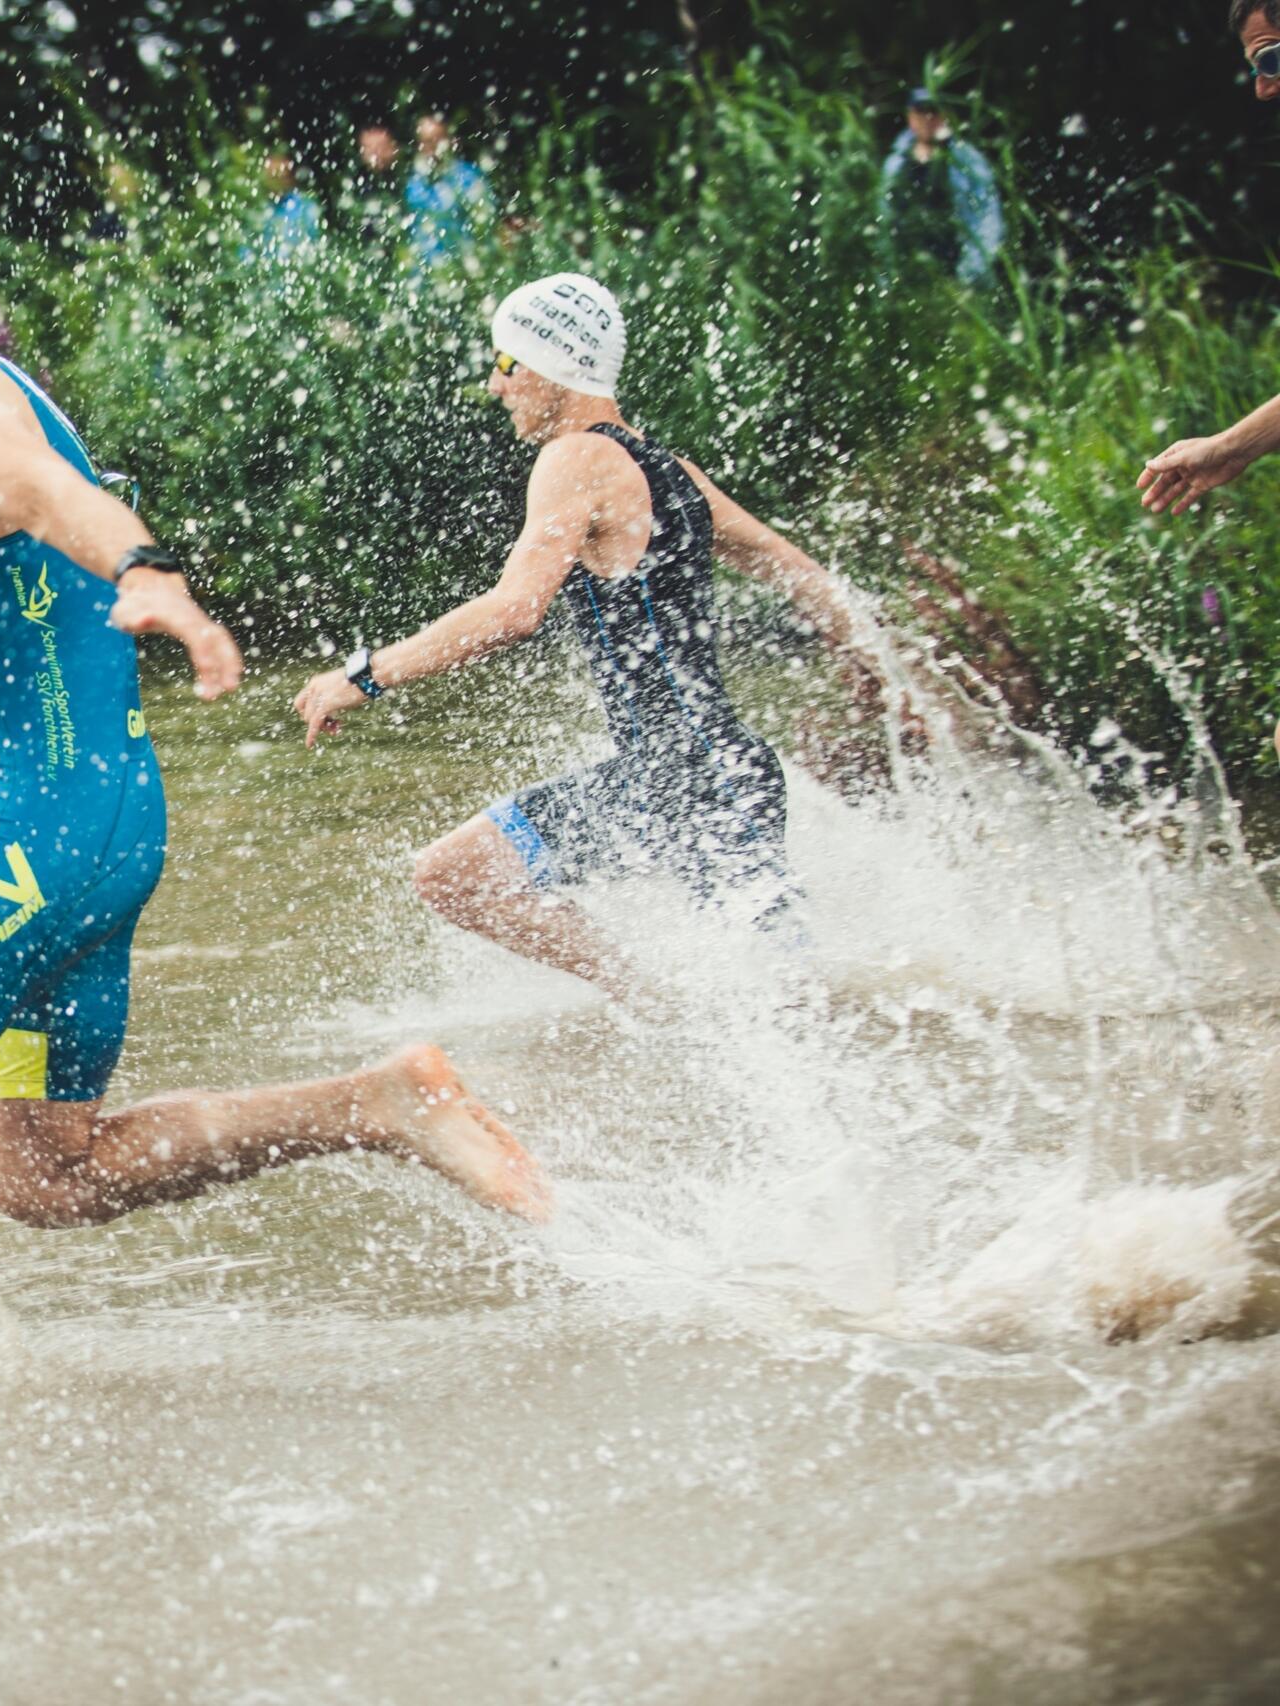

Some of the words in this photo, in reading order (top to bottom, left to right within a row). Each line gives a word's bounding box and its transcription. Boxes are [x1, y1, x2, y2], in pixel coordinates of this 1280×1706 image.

[11, 565, 27, 607] Triathlon
[36, 671, 53, 697] SSV
[41, 698, 59, 765] Forchheim
